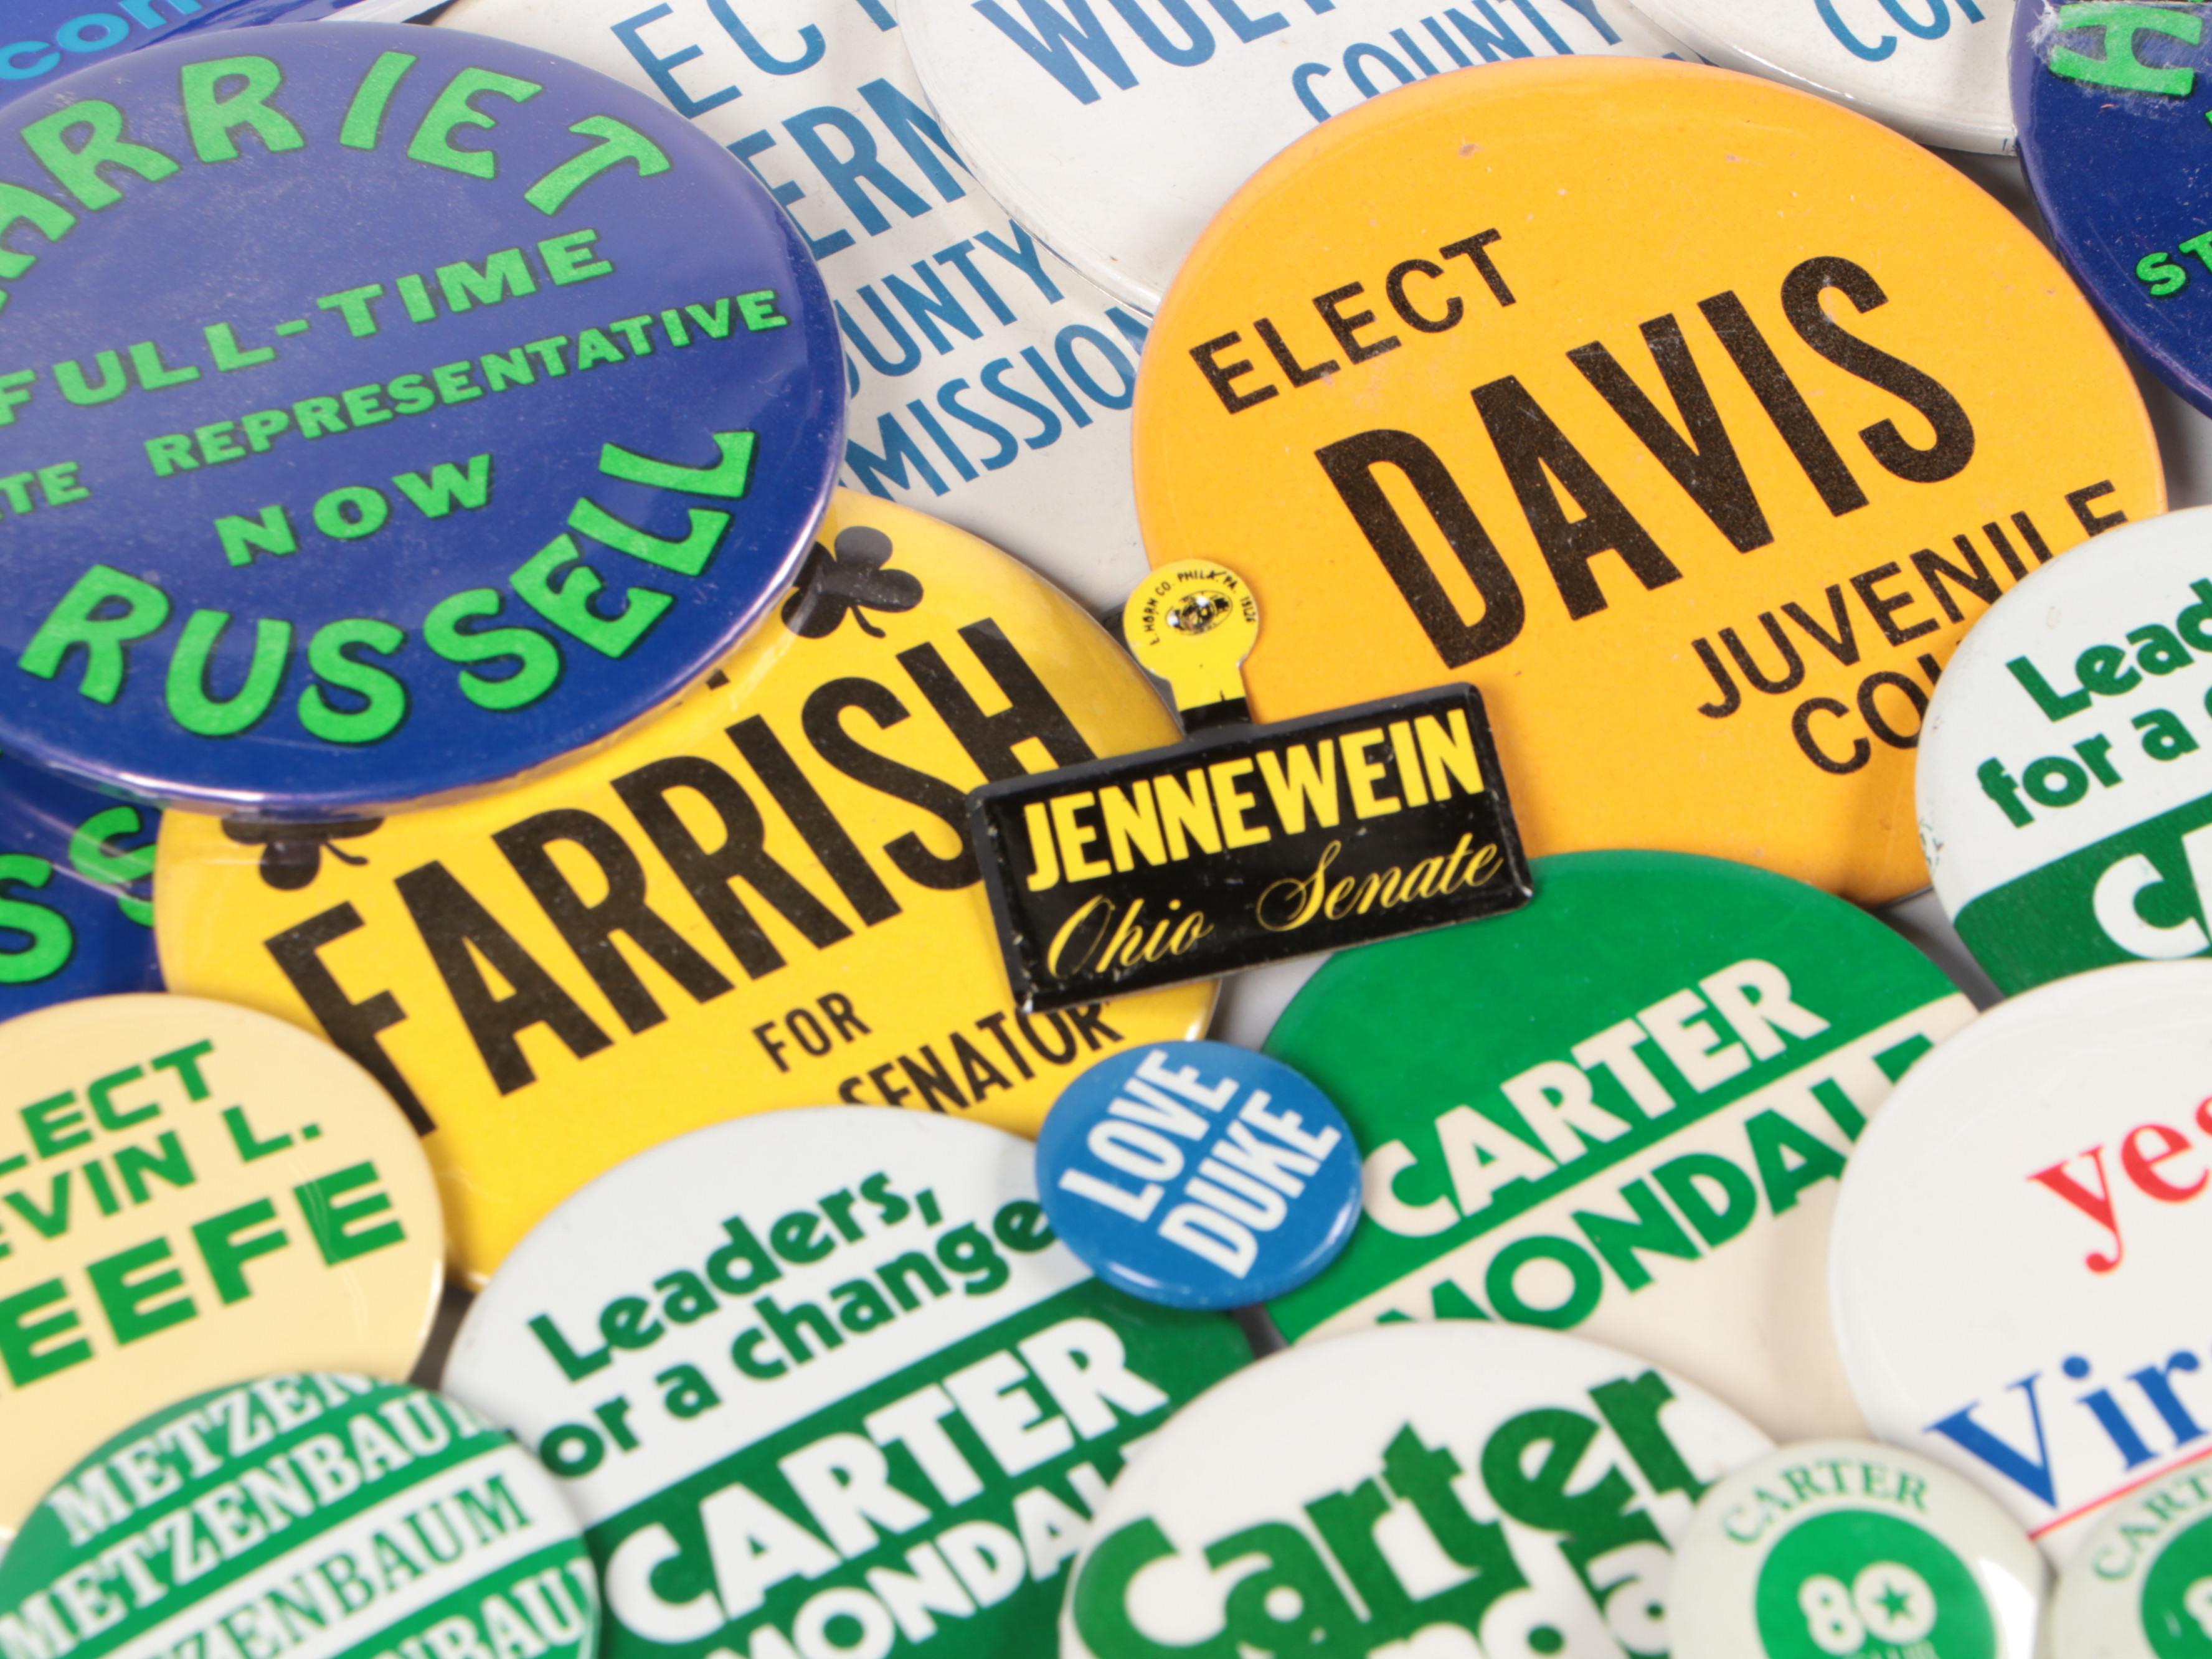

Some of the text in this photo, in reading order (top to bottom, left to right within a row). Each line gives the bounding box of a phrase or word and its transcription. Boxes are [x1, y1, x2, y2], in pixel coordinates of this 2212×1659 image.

[0, 51, 671, 311] ARRIET
[0, 229, 613, 426] FULL-TIME
[144, 290, 788, 477] REPRESENTATIVE
[1188, 227, 1518, 415] ELECT
[214, 453, 492, 567] NOW
[1315, 255, 1975, 670] DAVIS
[17, 430, 755, 744] RUSSELL
[1023, 707, 1485, 892] JENNEWEIN
[1976, 708, 2201, 830] for a
[263, 617, 1099, 1140] FARRISH
[1047, 832, 1504, 980] Ohio Senate
[752, 992, 872, 1074] FOR
[1363, 958, 1832, 1237] CARTER
[221, 1105, 323, 1163] L.
[1058, 1049, 1240, 1222] LOVE
[1157, 1089, 1343, 1280] DUKE
[1373, 1033, 1934, 1330] ONDA
[526, 1171, 944, 1383] Leaders,
[653, 1362, 723, 1421] a
[729, 1198, 1059, 1381] change
[605, 1317, 1170, 1645] CARTER
[1723, 1458, 1931, 1546] CARTER
[1922, 1349, 2212, 1510] Vir
[702, 1432, 1152, 1659] ONDA
